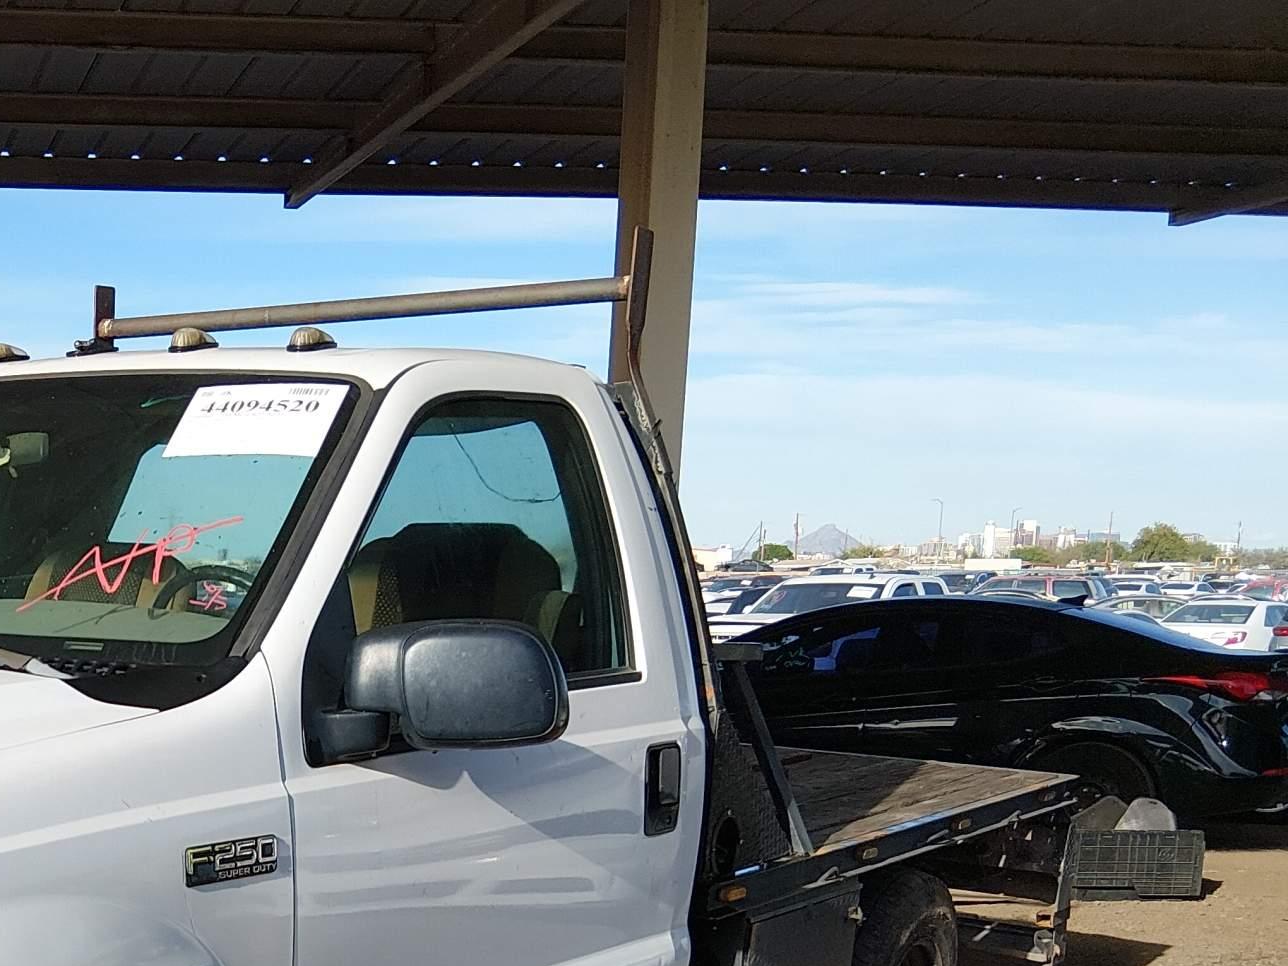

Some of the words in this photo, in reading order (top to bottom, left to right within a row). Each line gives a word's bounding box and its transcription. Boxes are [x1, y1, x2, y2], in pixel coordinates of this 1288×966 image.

[200, 399, 321, 414] 44094520
[218, 868, 251, 879] SUPER
[253, 862, 277, 874] DUTY
